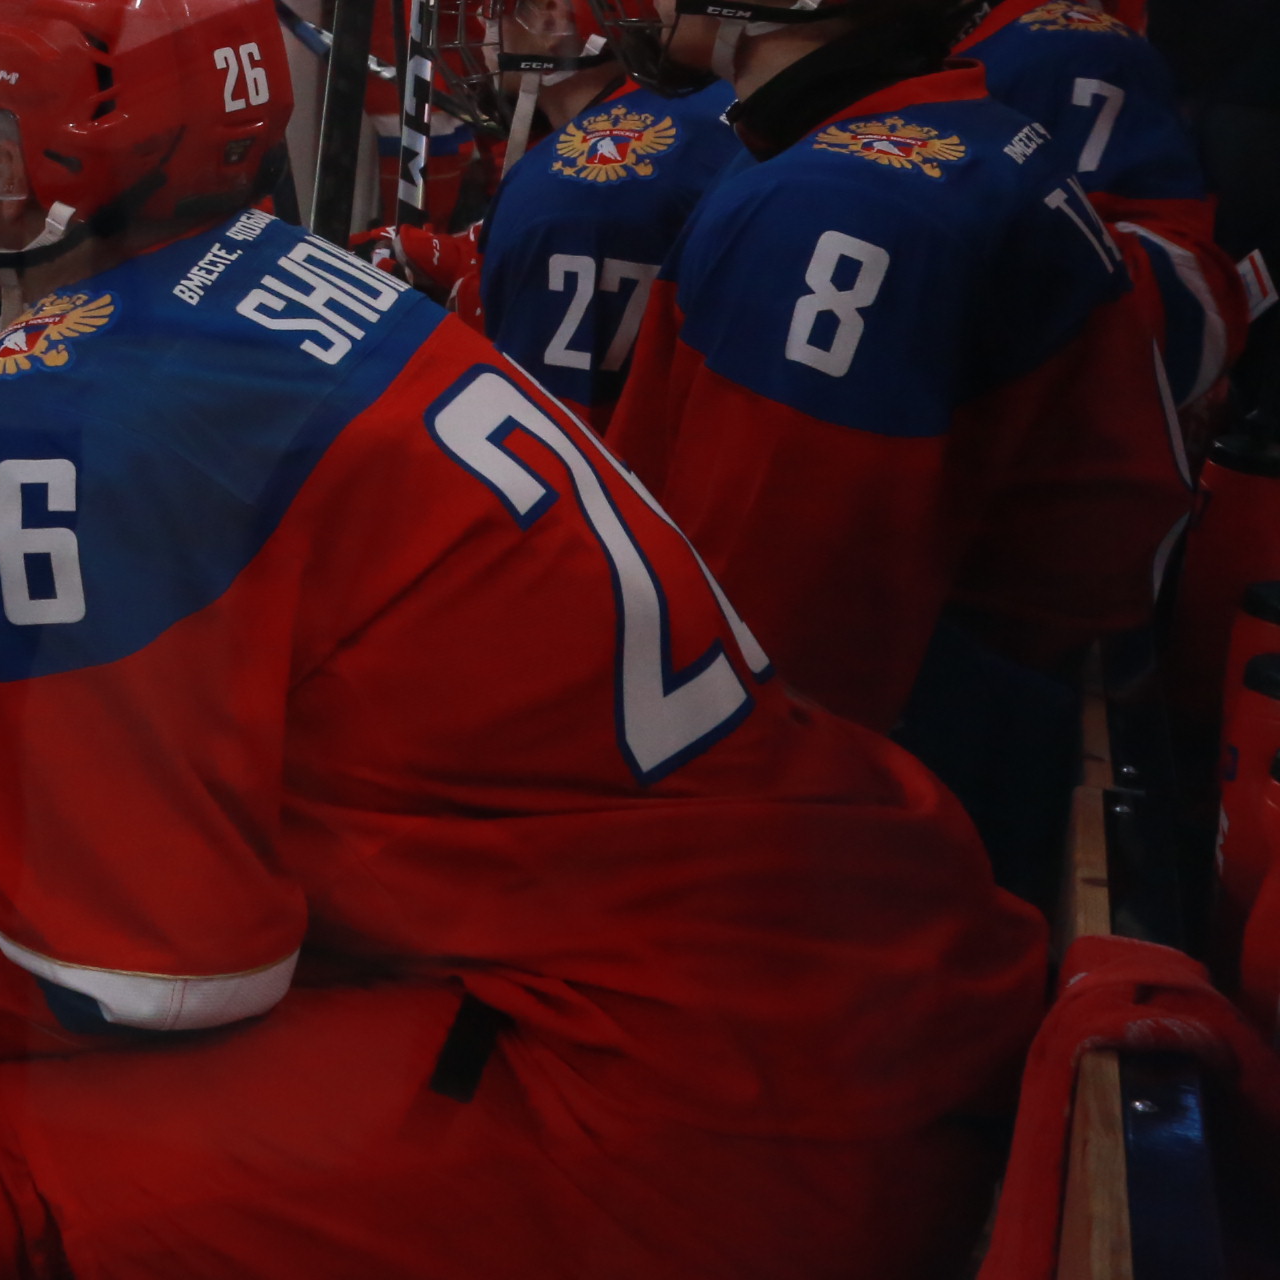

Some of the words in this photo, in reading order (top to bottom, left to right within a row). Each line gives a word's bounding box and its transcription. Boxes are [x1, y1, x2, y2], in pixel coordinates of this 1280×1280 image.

[706, 6, 753, 18] CCM
[212, 41, 271, 114] 26
[520, 62, 555, 70] CCM
[1071, 77, 1126, 173] 7
[172, 242, 244, 306] ВМЕСТЕ,
[543, 253, 662, 372] 27
[784, 231, 891, 378] 8
[425, 355, 775, 784] 2
